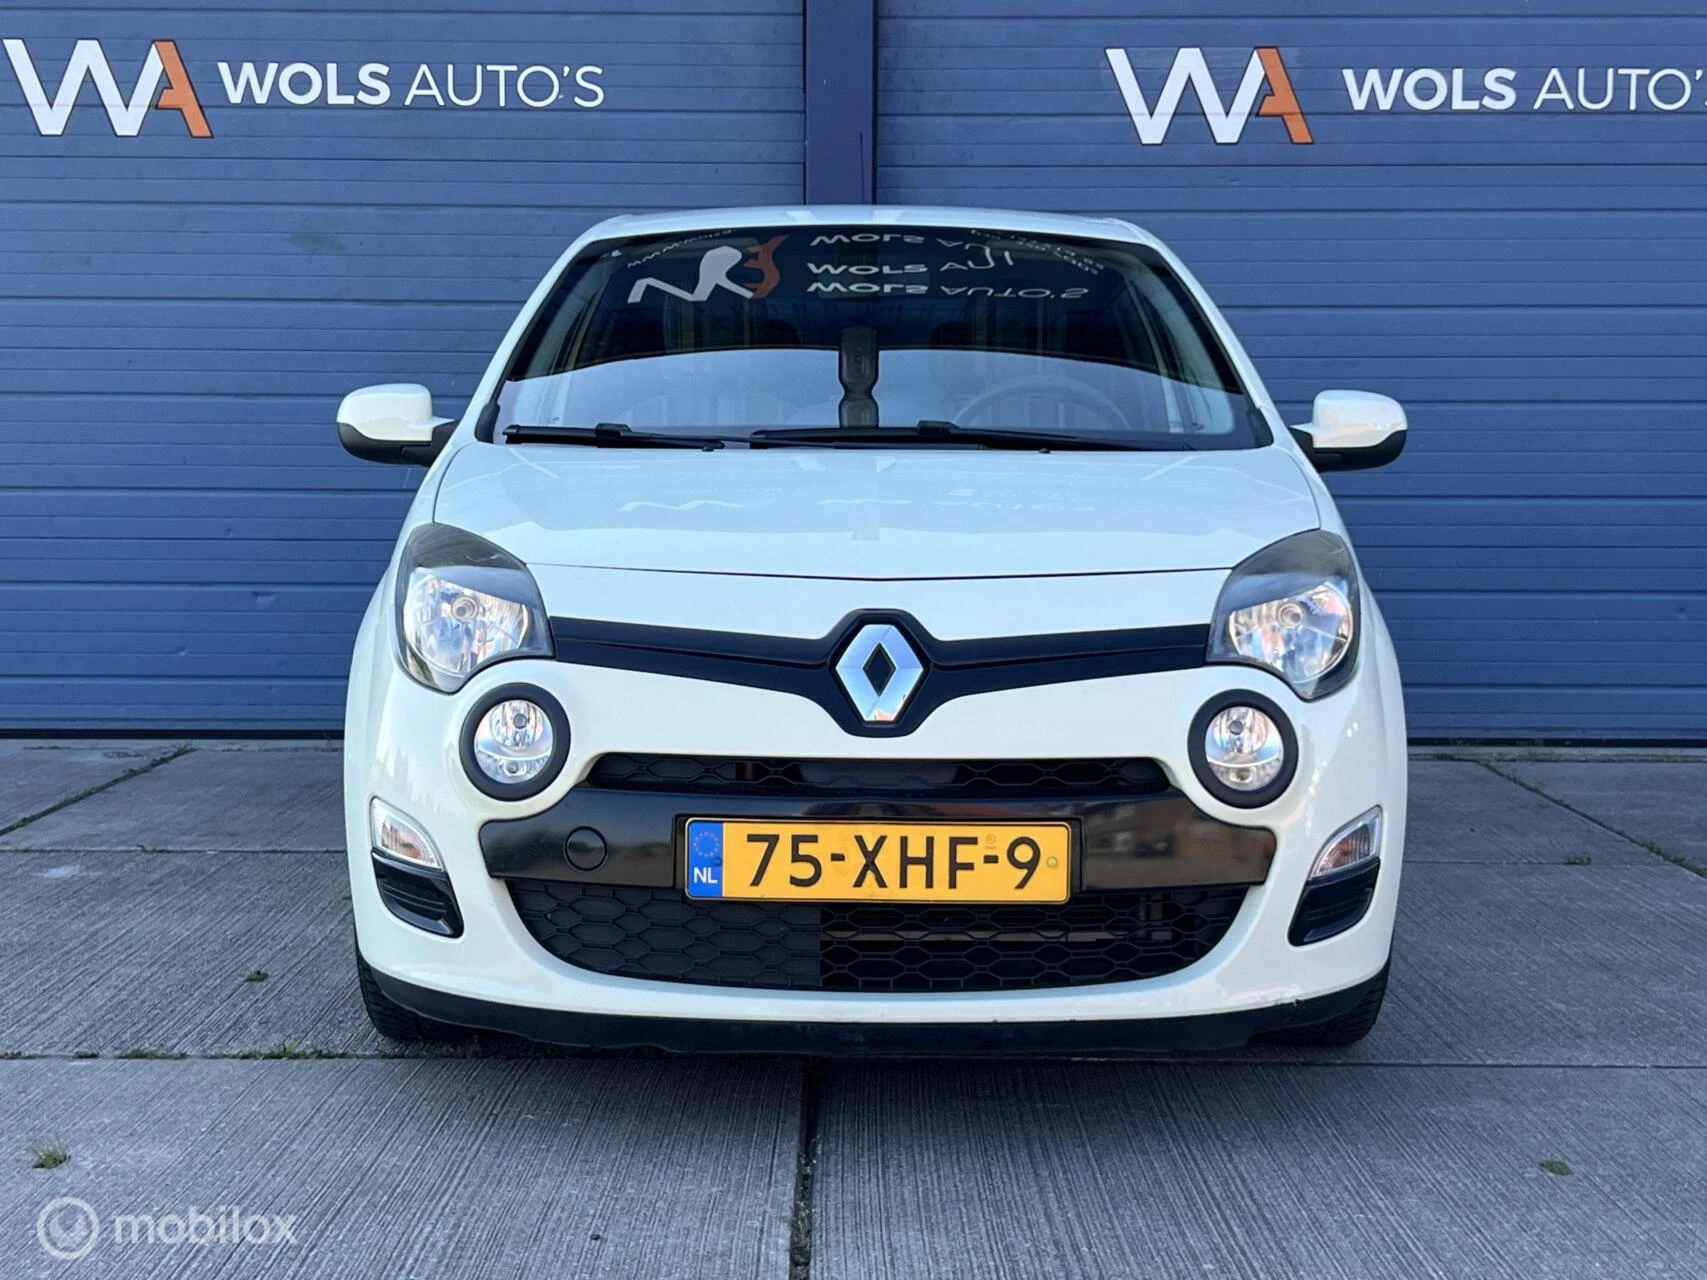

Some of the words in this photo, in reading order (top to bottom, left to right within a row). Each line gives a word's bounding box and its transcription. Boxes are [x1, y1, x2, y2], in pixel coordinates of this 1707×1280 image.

[217, 61, 391, 105] WOLS
[403, 63, 605, 108] AUTO'S
[1341, 67, 1518, 112] WOLS
[1532, 67, 1707, 112] AUTO'
[807, 262, 928, 275] WOLS
[693, 866, 718, 884] NL
[746, 833, 1041, 890] 75-XHF-9
